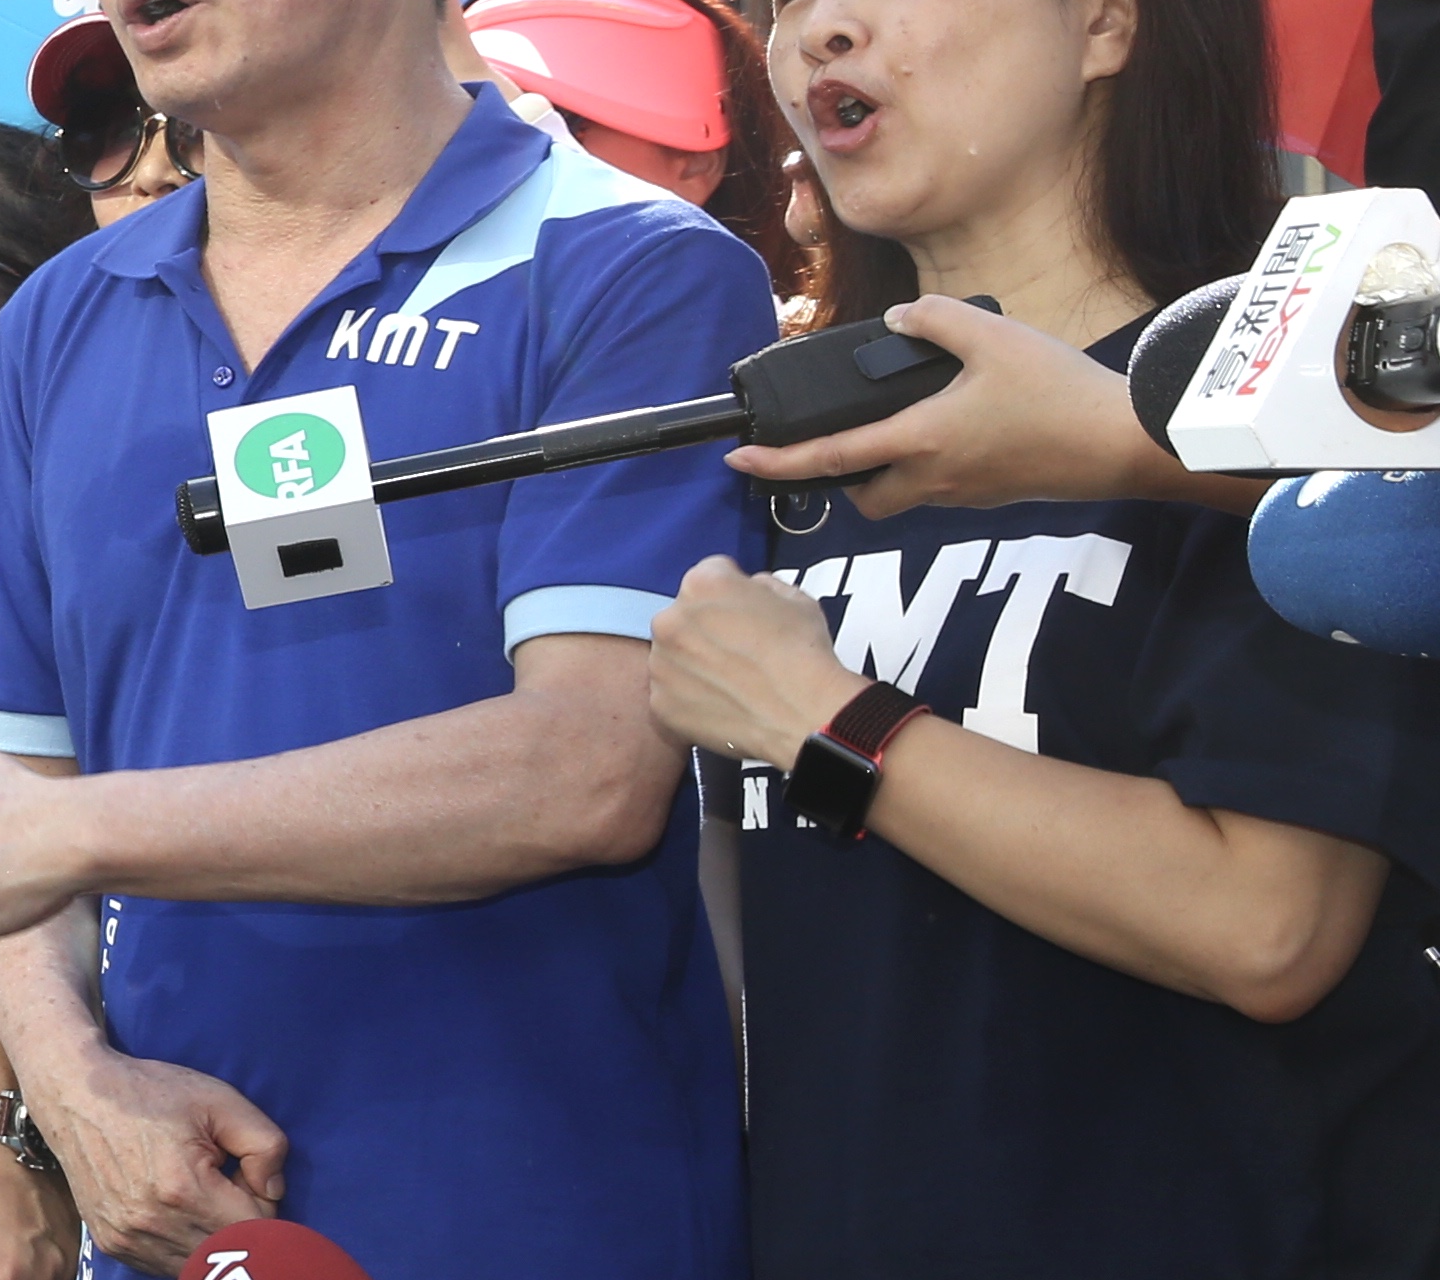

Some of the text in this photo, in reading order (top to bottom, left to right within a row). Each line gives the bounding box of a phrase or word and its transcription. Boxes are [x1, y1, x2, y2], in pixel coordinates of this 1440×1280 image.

[326, 308, 481, 371] KMT
[1197, 223, 1321, 399] 壹新聞
[268, 429, 315, 500] RFA
